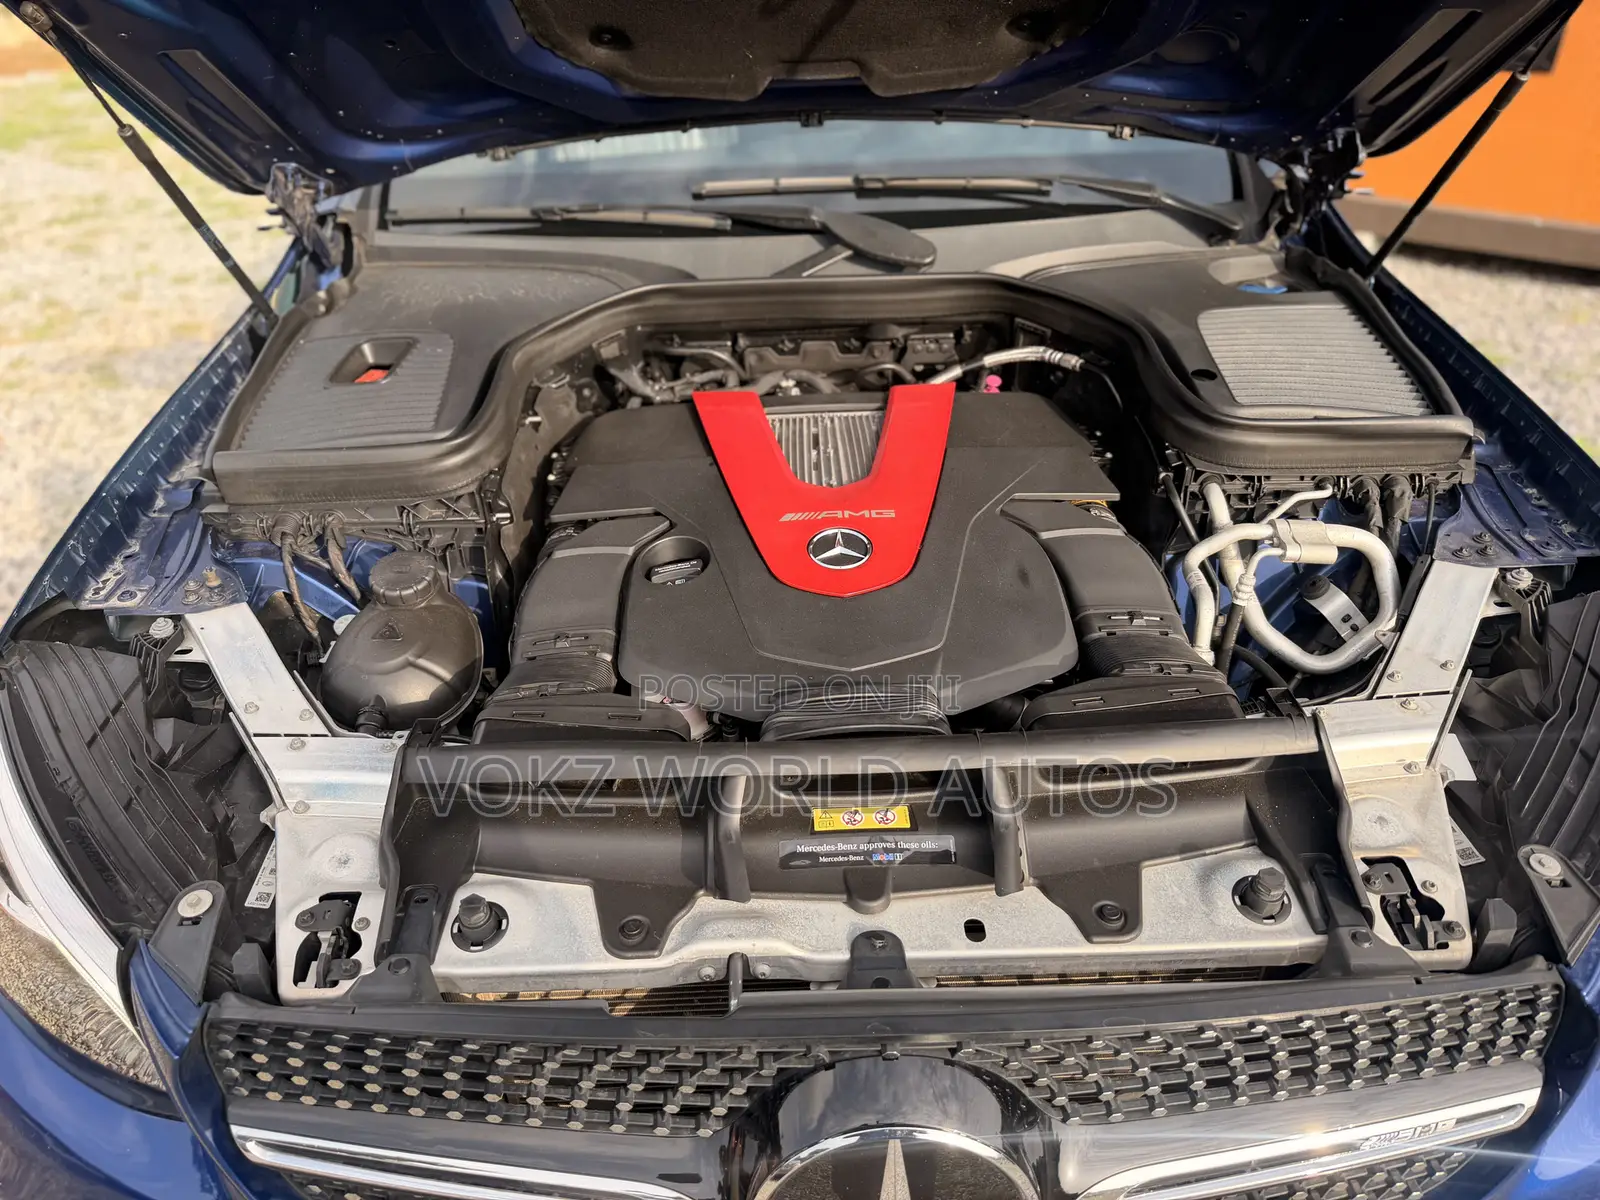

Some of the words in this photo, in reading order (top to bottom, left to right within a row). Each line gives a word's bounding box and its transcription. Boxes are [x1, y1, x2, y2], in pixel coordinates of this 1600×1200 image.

[815, 509, 896, 520] AMG
[796, 842, 858, 853] Mercedes-Benz
[859, 841, 898, 851] approves
[897, 840, 920, 849] these
[920, 840, 939, 849] oils:
[818, 854, 865, 863] Mercedes-Benz
[872, 853, 894, 861] Mobil
